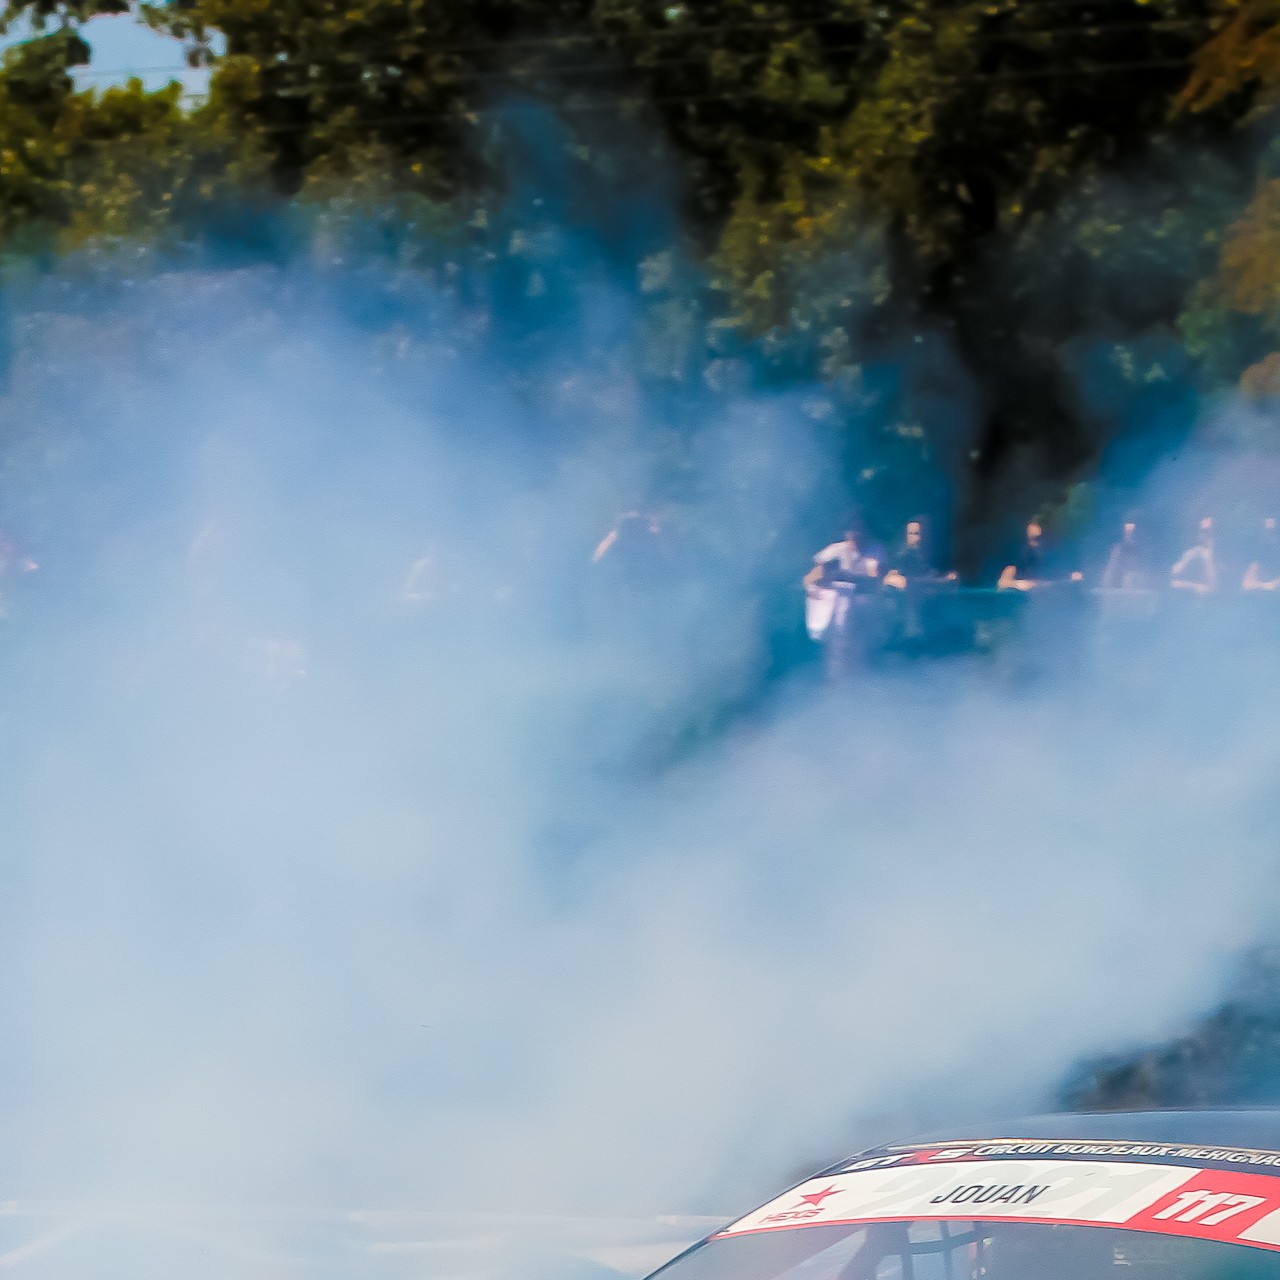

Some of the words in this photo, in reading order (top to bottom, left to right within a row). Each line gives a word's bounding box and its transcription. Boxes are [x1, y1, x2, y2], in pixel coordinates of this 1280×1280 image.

[973, 1143, 1058, 1156] CIRCUIT
[929, 1184, 1050, 1204] JOUAN
[1152, 1188, 1268, 1226] 117
